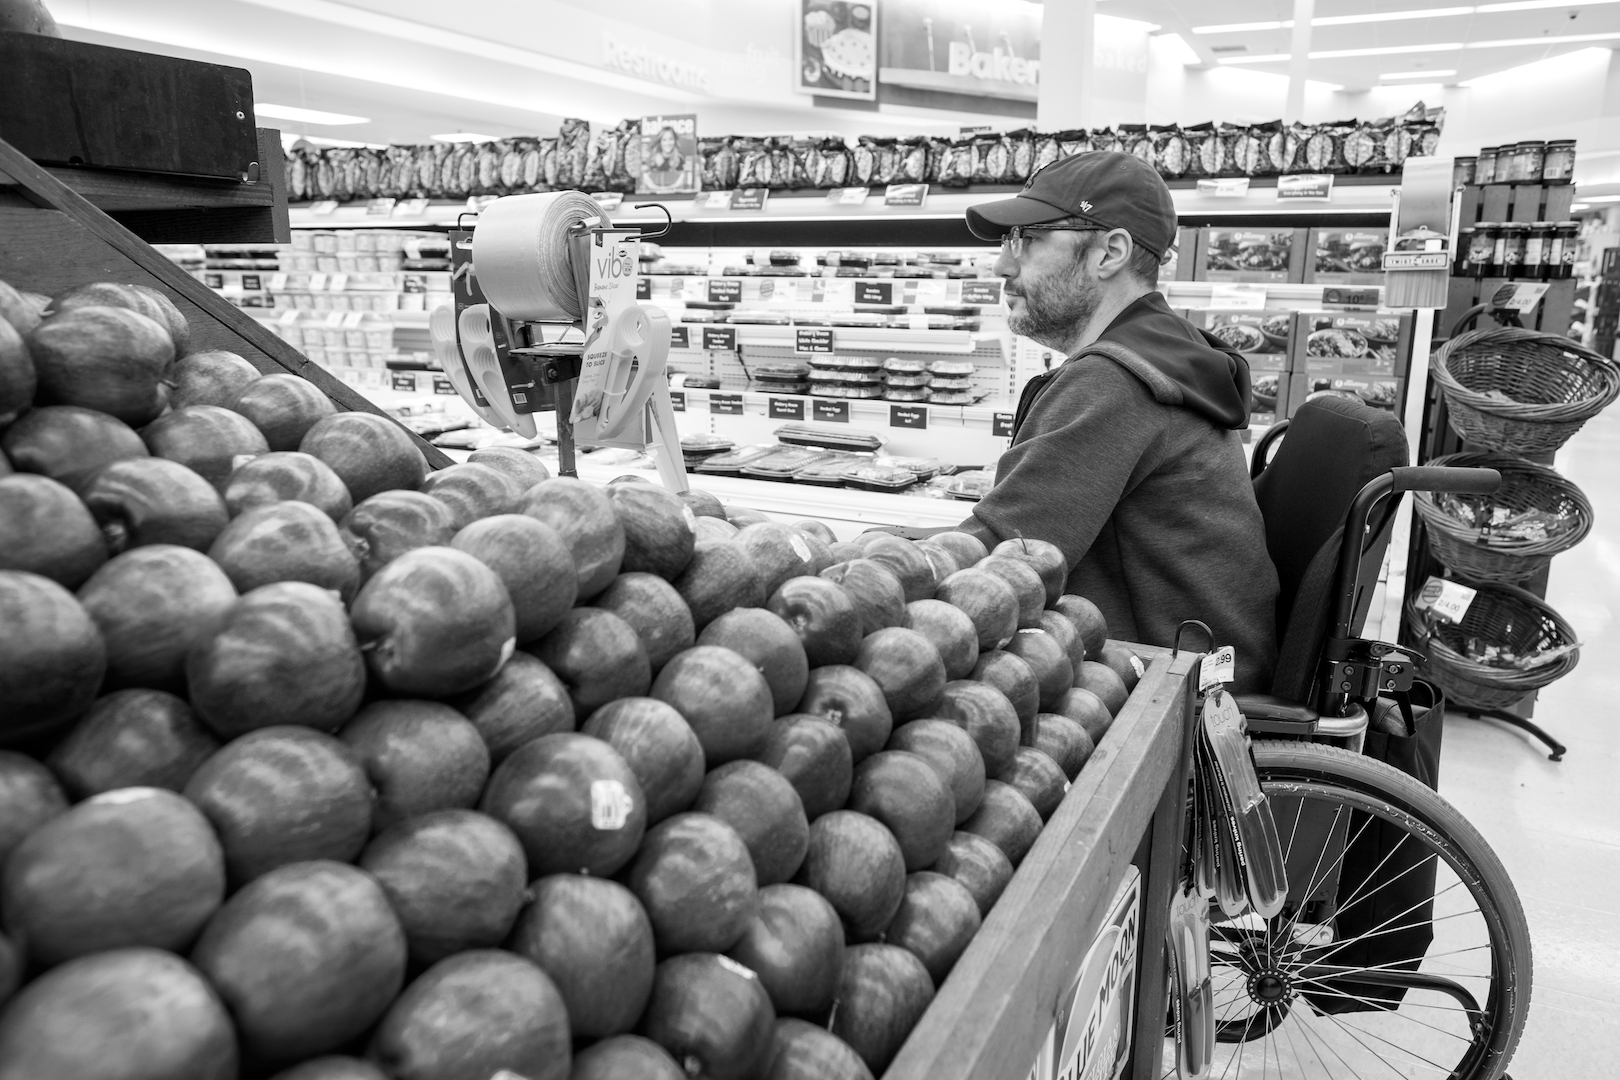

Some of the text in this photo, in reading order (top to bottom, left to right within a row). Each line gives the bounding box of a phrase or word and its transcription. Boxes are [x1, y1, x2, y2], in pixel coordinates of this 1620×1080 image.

[602, 32, 710, 90] Restrooms
[949, 41, 1040, 85] Baker
[587, 351, 608, 361] SQUEEZE
[1437, 598, 1461, 612] 2/4.00
[1209, 704, 1235, 728] touch
[1211, 819, 1220, 844] knives
[1230, 815, 1246, 867] paring knives
[1175, 895, 1201, 918] touch
[1098, 907, 1137, 1030] MOON
